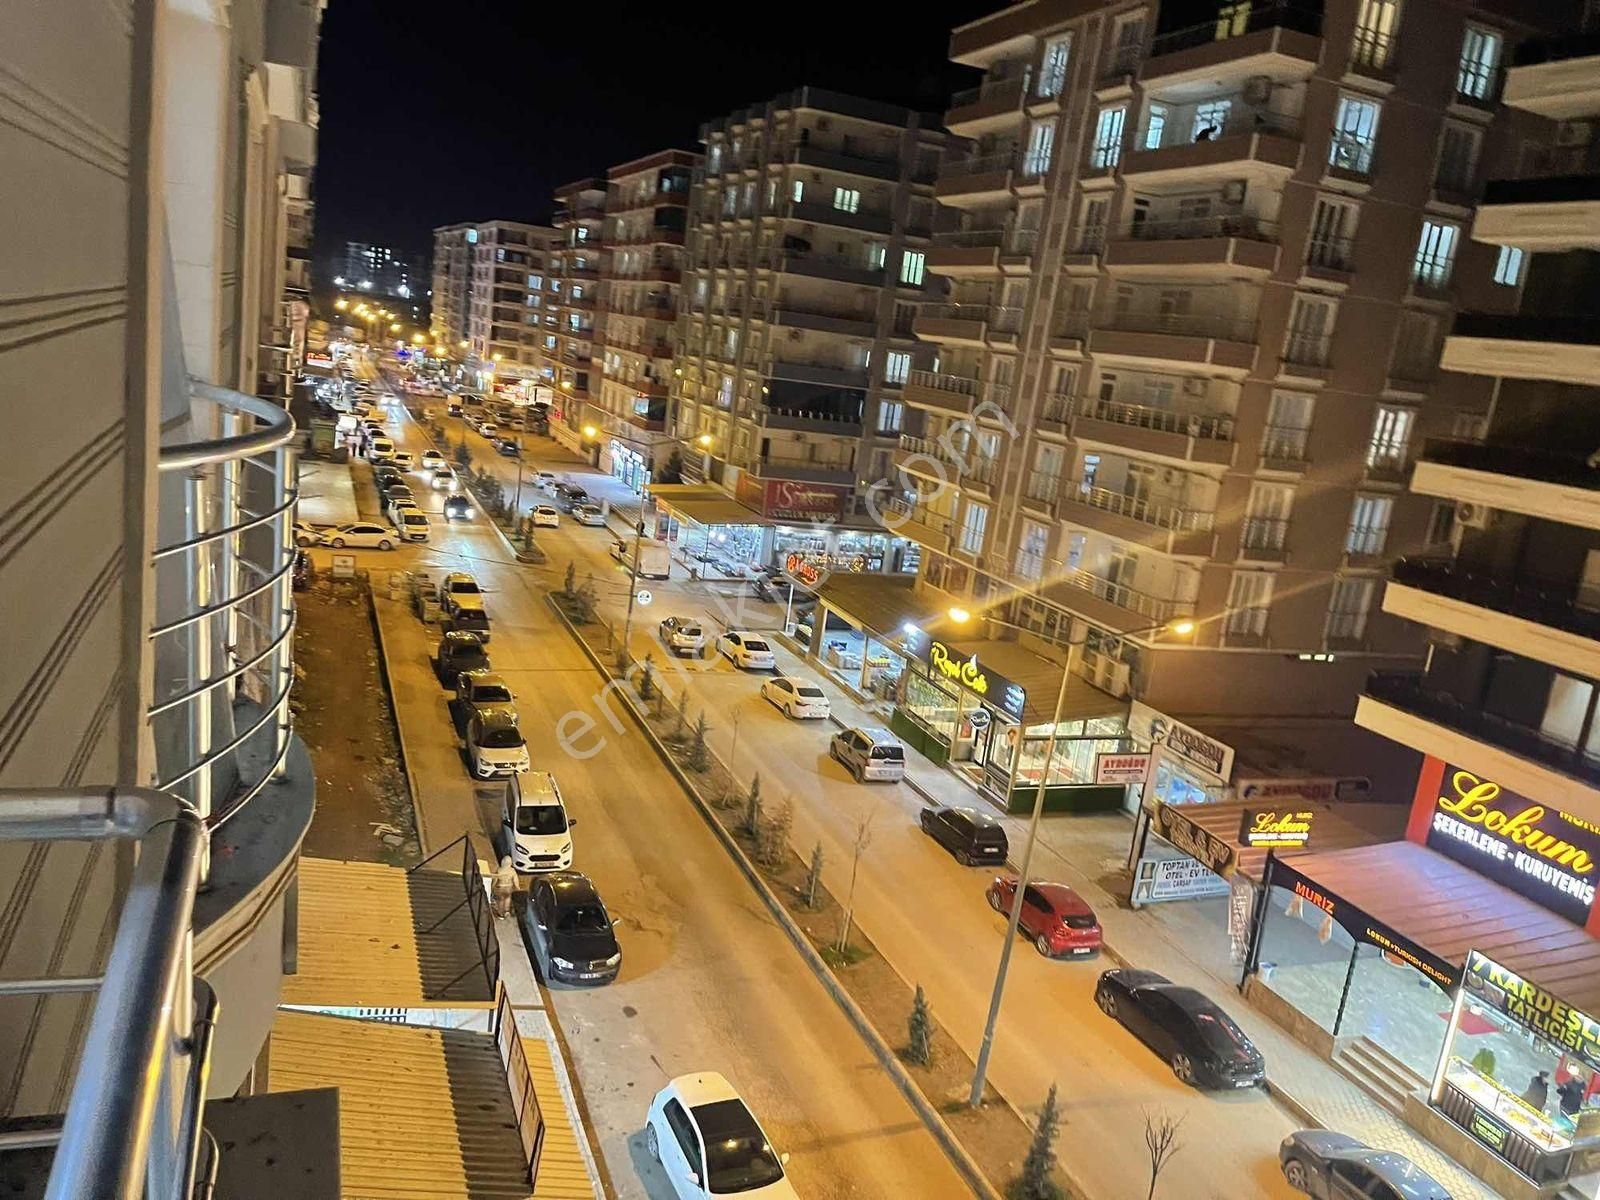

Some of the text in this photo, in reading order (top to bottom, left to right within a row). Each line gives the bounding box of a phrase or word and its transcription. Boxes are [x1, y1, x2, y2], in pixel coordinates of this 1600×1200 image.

[1250, 812, 1310, 832] Lokum
[1433, 812, 1509, 861] ŞEKERLEME
[1438, 771, 1594, 873] Lokum
[1422, 963, 1453, 986] DELIGHT
